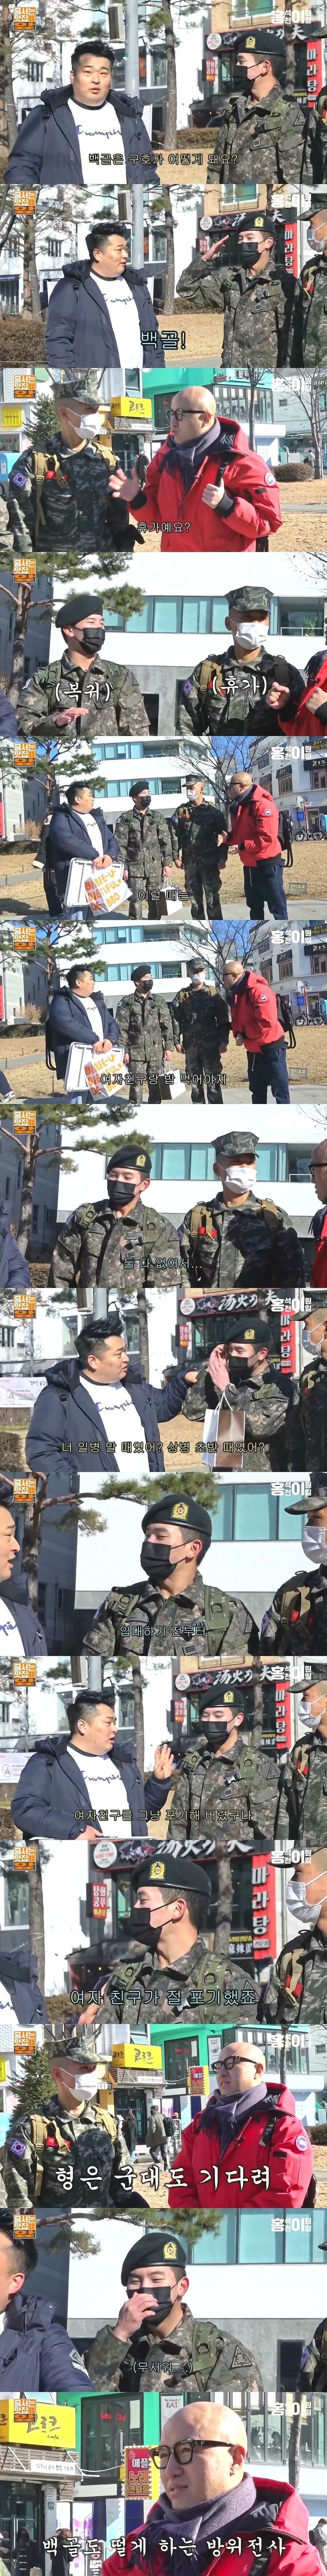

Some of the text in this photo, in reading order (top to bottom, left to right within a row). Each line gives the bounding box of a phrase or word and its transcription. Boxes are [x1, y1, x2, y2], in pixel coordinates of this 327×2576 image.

[275, 1690, 287, 1734] 마라탕
[252, 1867, 269, 1935] 마라탕
[134, 2048, 153, 2062] 코르크
[132, 2458, 149, 2468] 애플
[129, 2471, 149, 2484] 노래
[128, 2485, 150, 2494] 연습장
